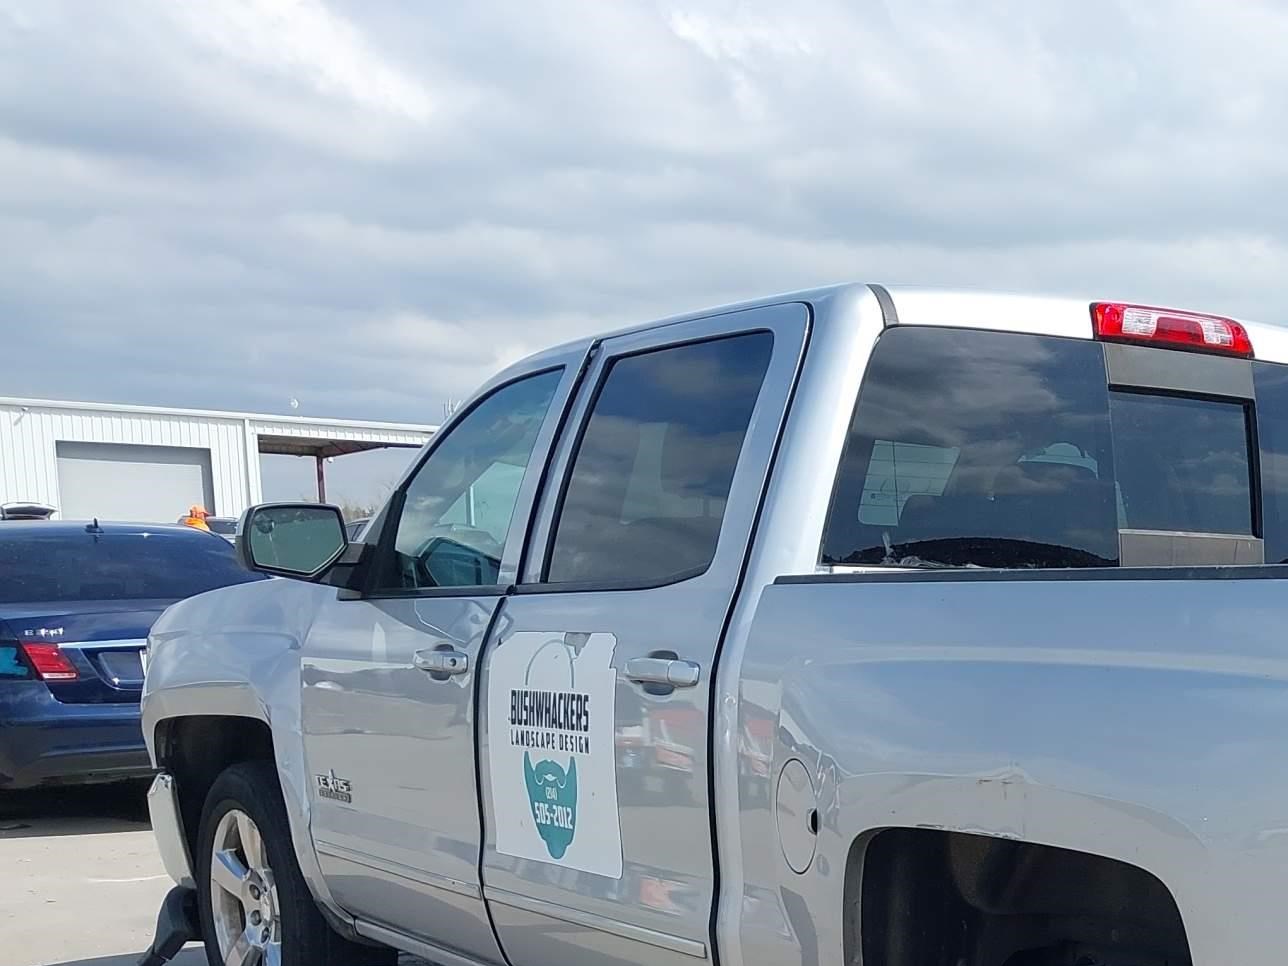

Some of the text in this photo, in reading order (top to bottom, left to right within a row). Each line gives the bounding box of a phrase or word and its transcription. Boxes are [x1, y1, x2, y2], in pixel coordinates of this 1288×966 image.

[510, 689, 589, 732] BUSHWHACKERS
[510, 728, 590, 754] LANDSCAPE DESIGN
[534, 801, 574, 830] 505-2012
